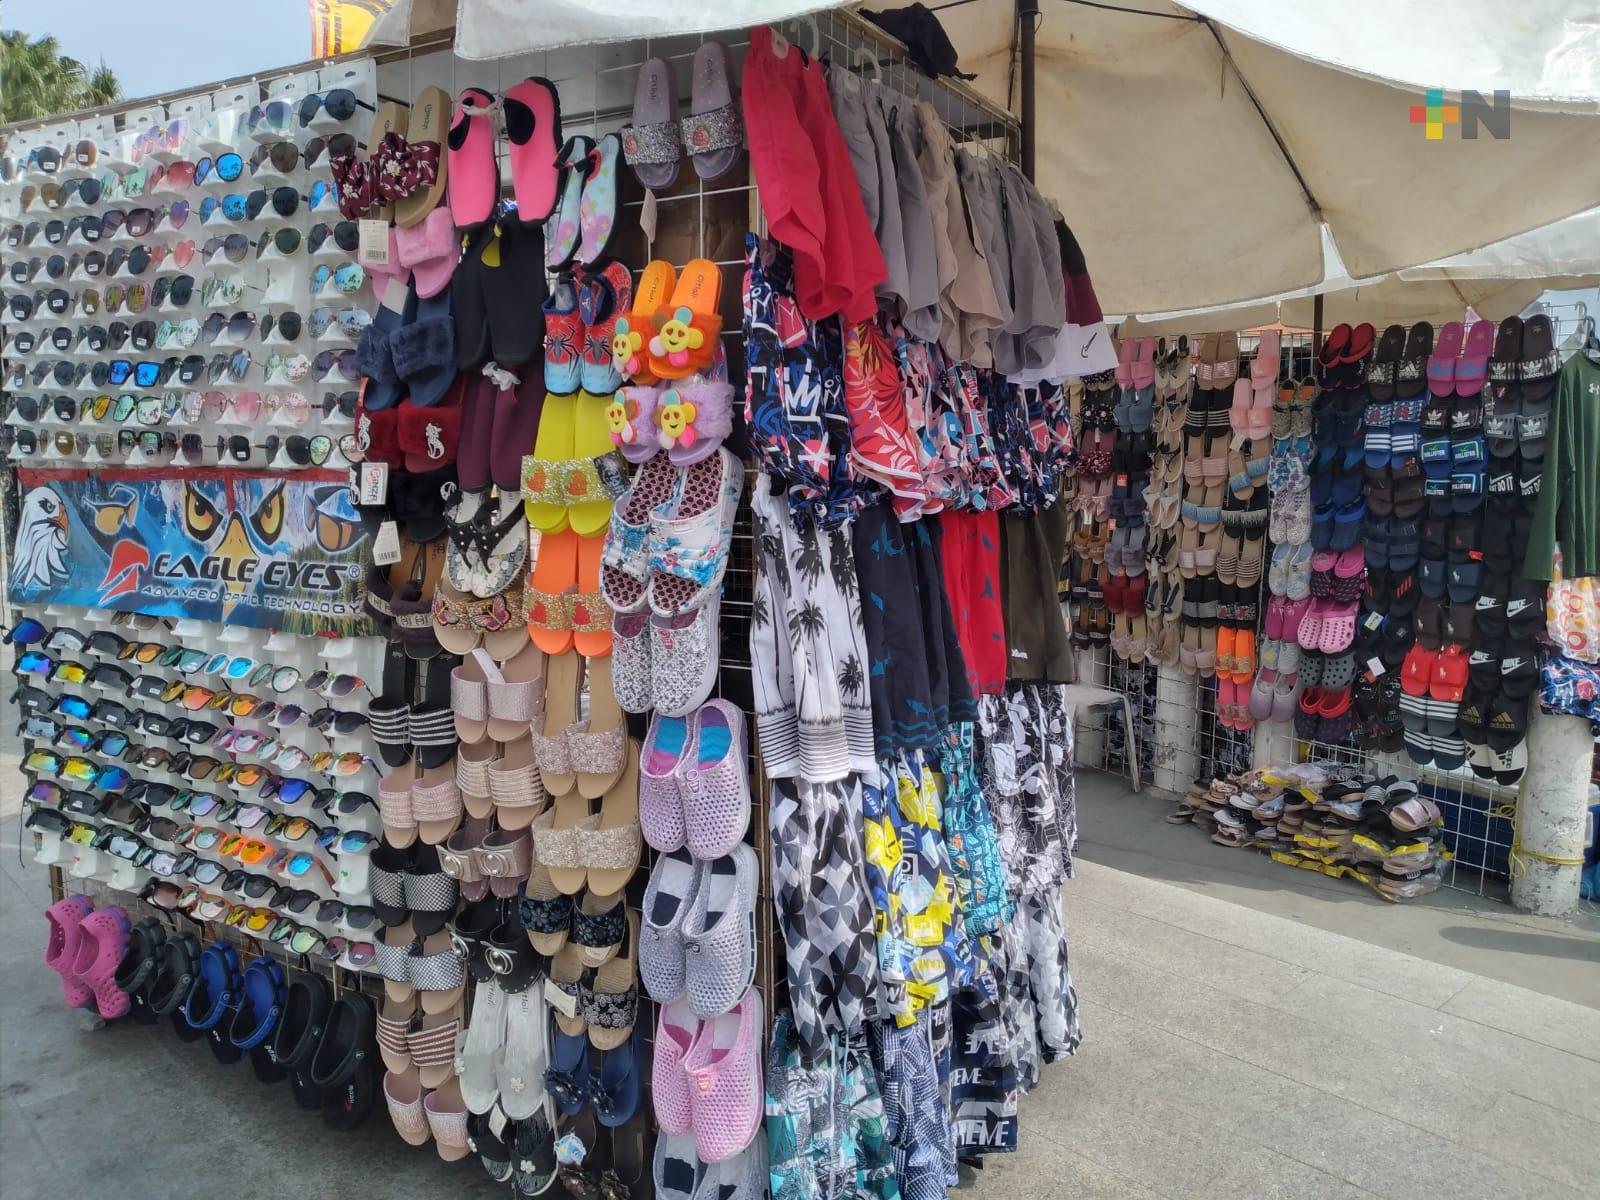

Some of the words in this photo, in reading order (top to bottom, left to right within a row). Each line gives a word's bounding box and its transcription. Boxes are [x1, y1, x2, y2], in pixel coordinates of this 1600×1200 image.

[153, 554, 258, 583] EAGLE
[141, 586, 219, 601] ADVANCED
[223, 592, 258, 606] OPTIC
[264, 596, 361, 614] TECHNOLOGY
